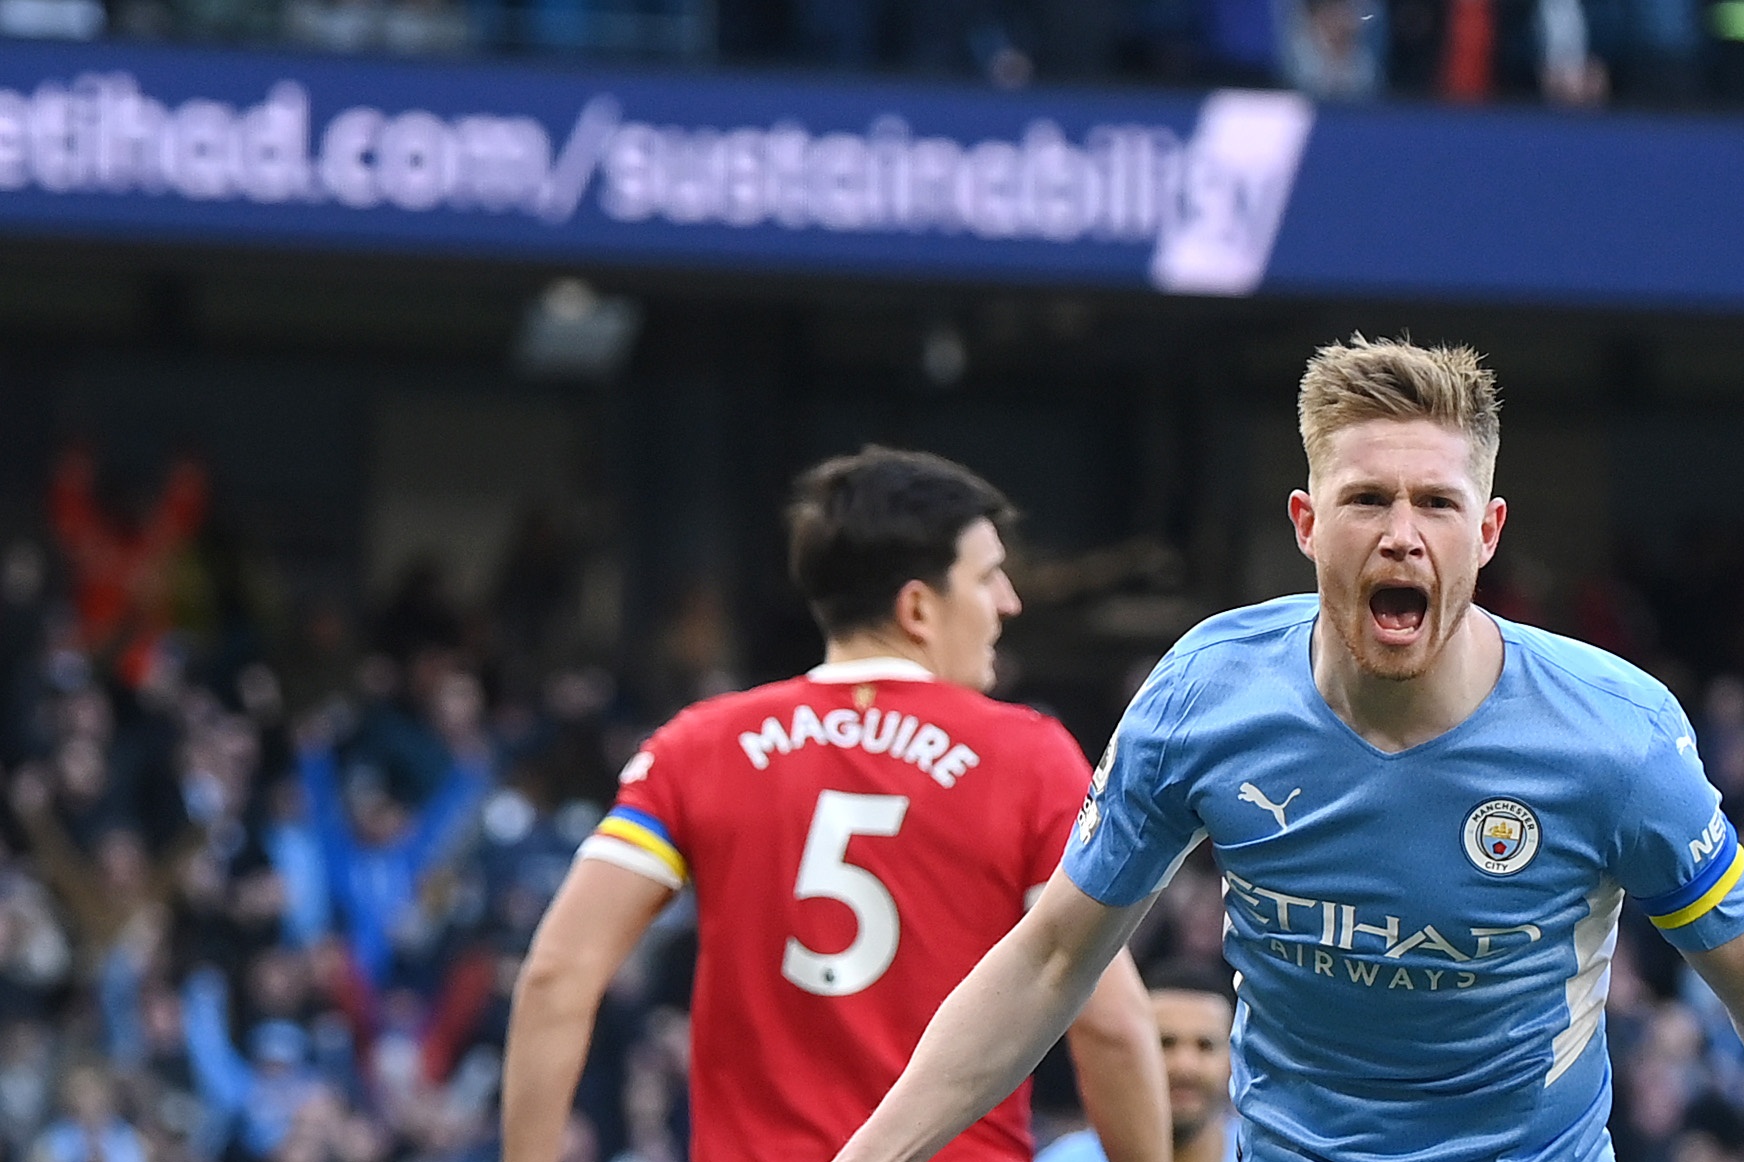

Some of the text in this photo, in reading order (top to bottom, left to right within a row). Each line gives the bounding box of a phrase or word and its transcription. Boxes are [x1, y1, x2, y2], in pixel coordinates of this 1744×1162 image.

[738, 705, 980, 788] MAGUIRE
[1472, 802, 1535, 831] MANCHESTER
[781, 789, 909, 996] 5
[1485, 861, 1508, 871] CITY
[1225, 870, 1541, 961] ETIHAD
